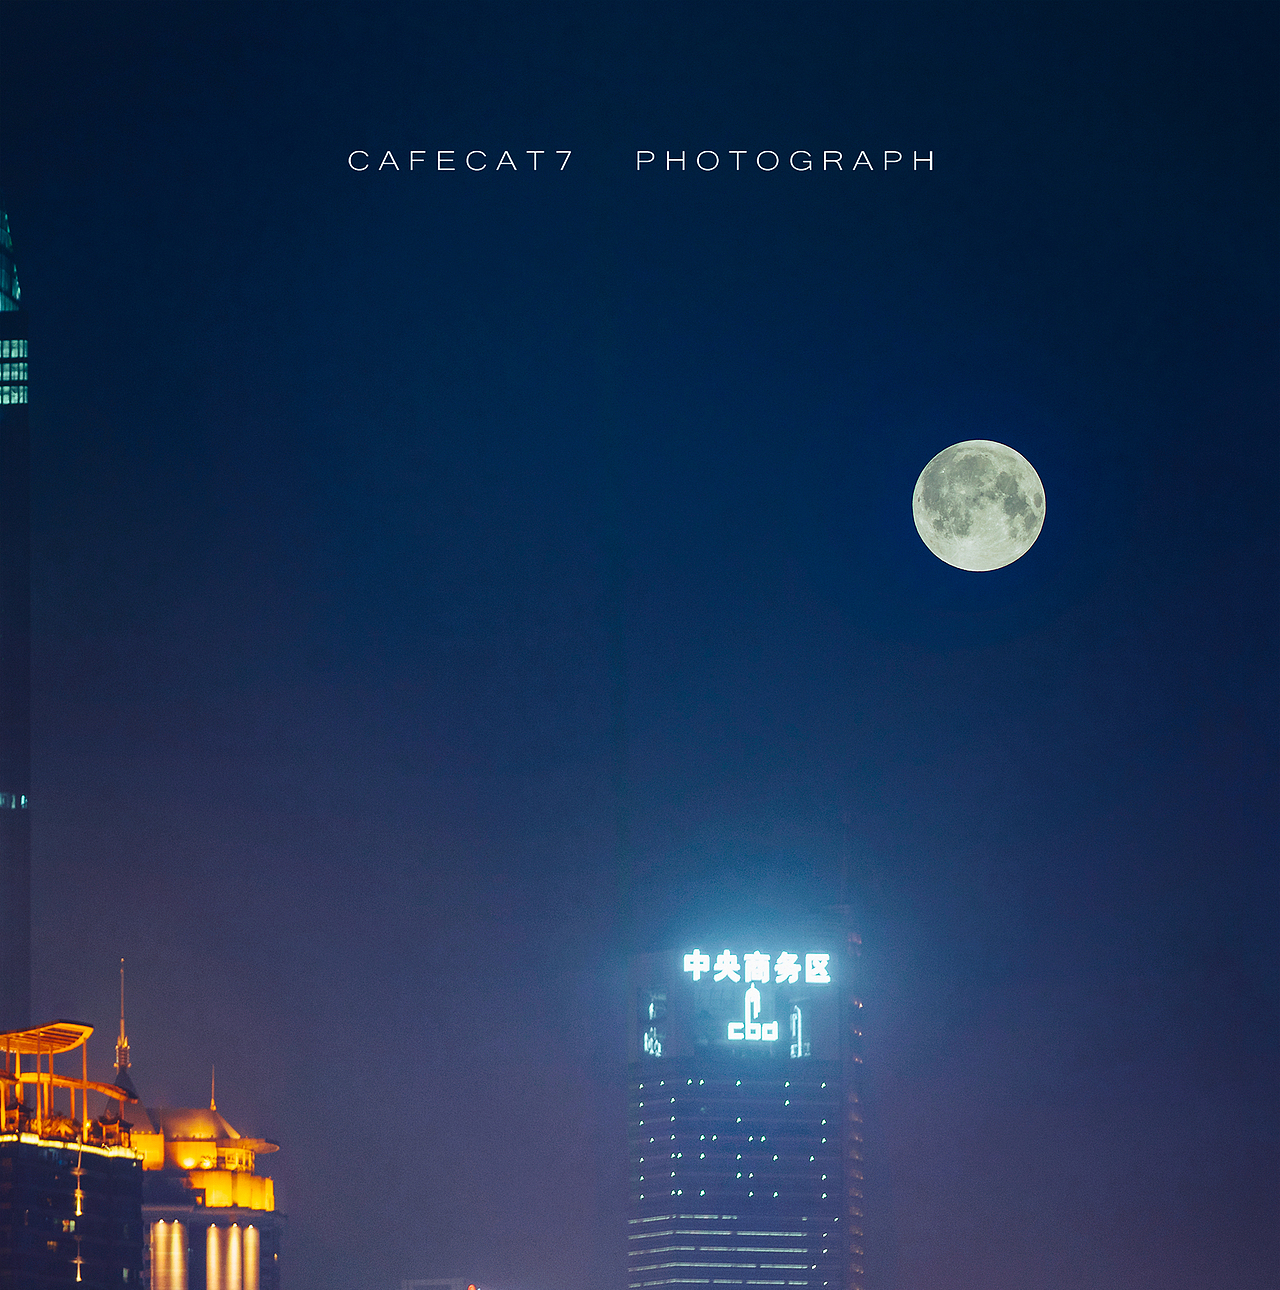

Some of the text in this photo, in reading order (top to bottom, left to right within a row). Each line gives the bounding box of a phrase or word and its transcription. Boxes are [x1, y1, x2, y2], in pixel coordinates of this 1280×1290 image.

[683, 948, 831, 984] 中央商务区
